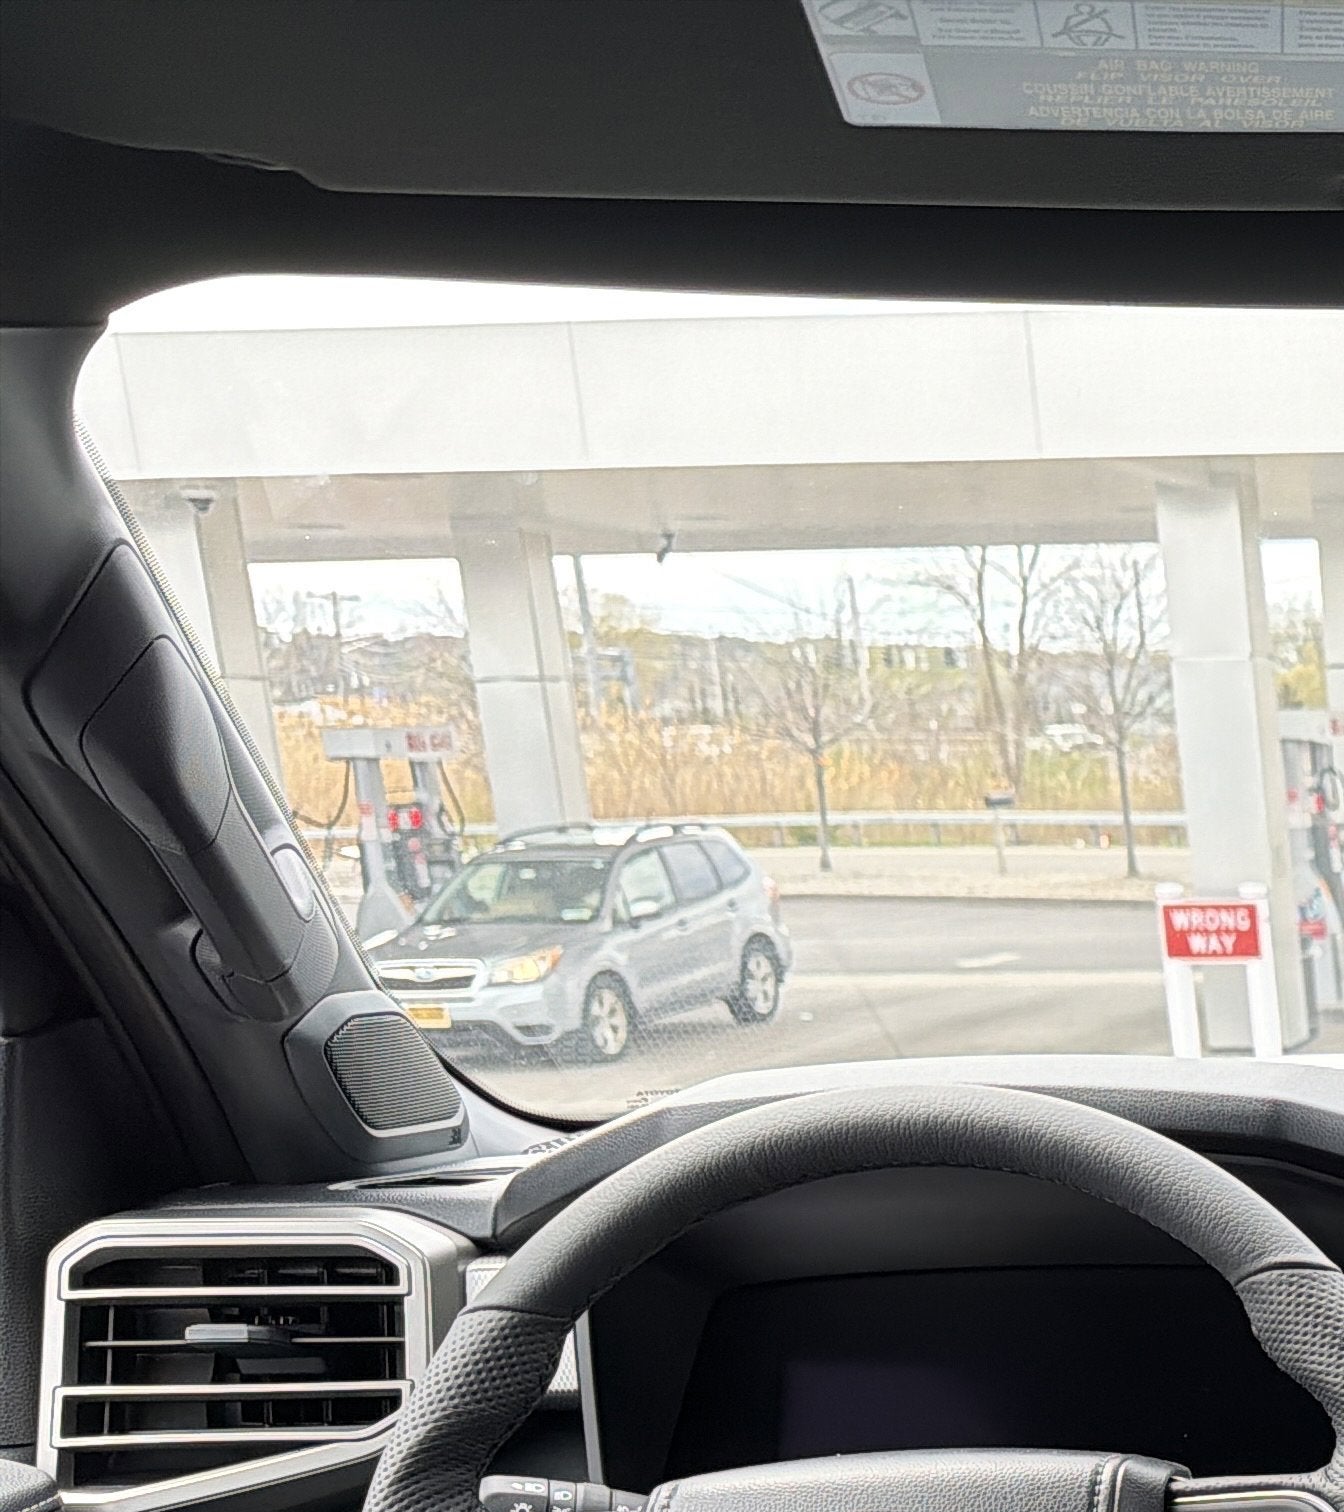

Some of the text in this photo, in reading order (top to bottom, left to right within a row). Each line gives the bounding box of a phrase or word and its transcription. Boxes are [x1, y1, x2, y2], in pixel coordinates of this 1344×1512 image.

[1100, 59, 1259, 73] AIR BAG WARNING
[1139, 73, 1205, 83] VISOR
[1221, 74, 1282, 83] OVER
[1022, 81, 1096, 96] COUSSIN
[1205, 86, 1335, 98] AVERTISSEMENT
[1029, 106, 1335, 121] ADVERTENCIA CON LA BOLSA DE AIRE
[1168, 907, 1252, 932] WRONG
[1186, 931, 1237, 955] WAY
